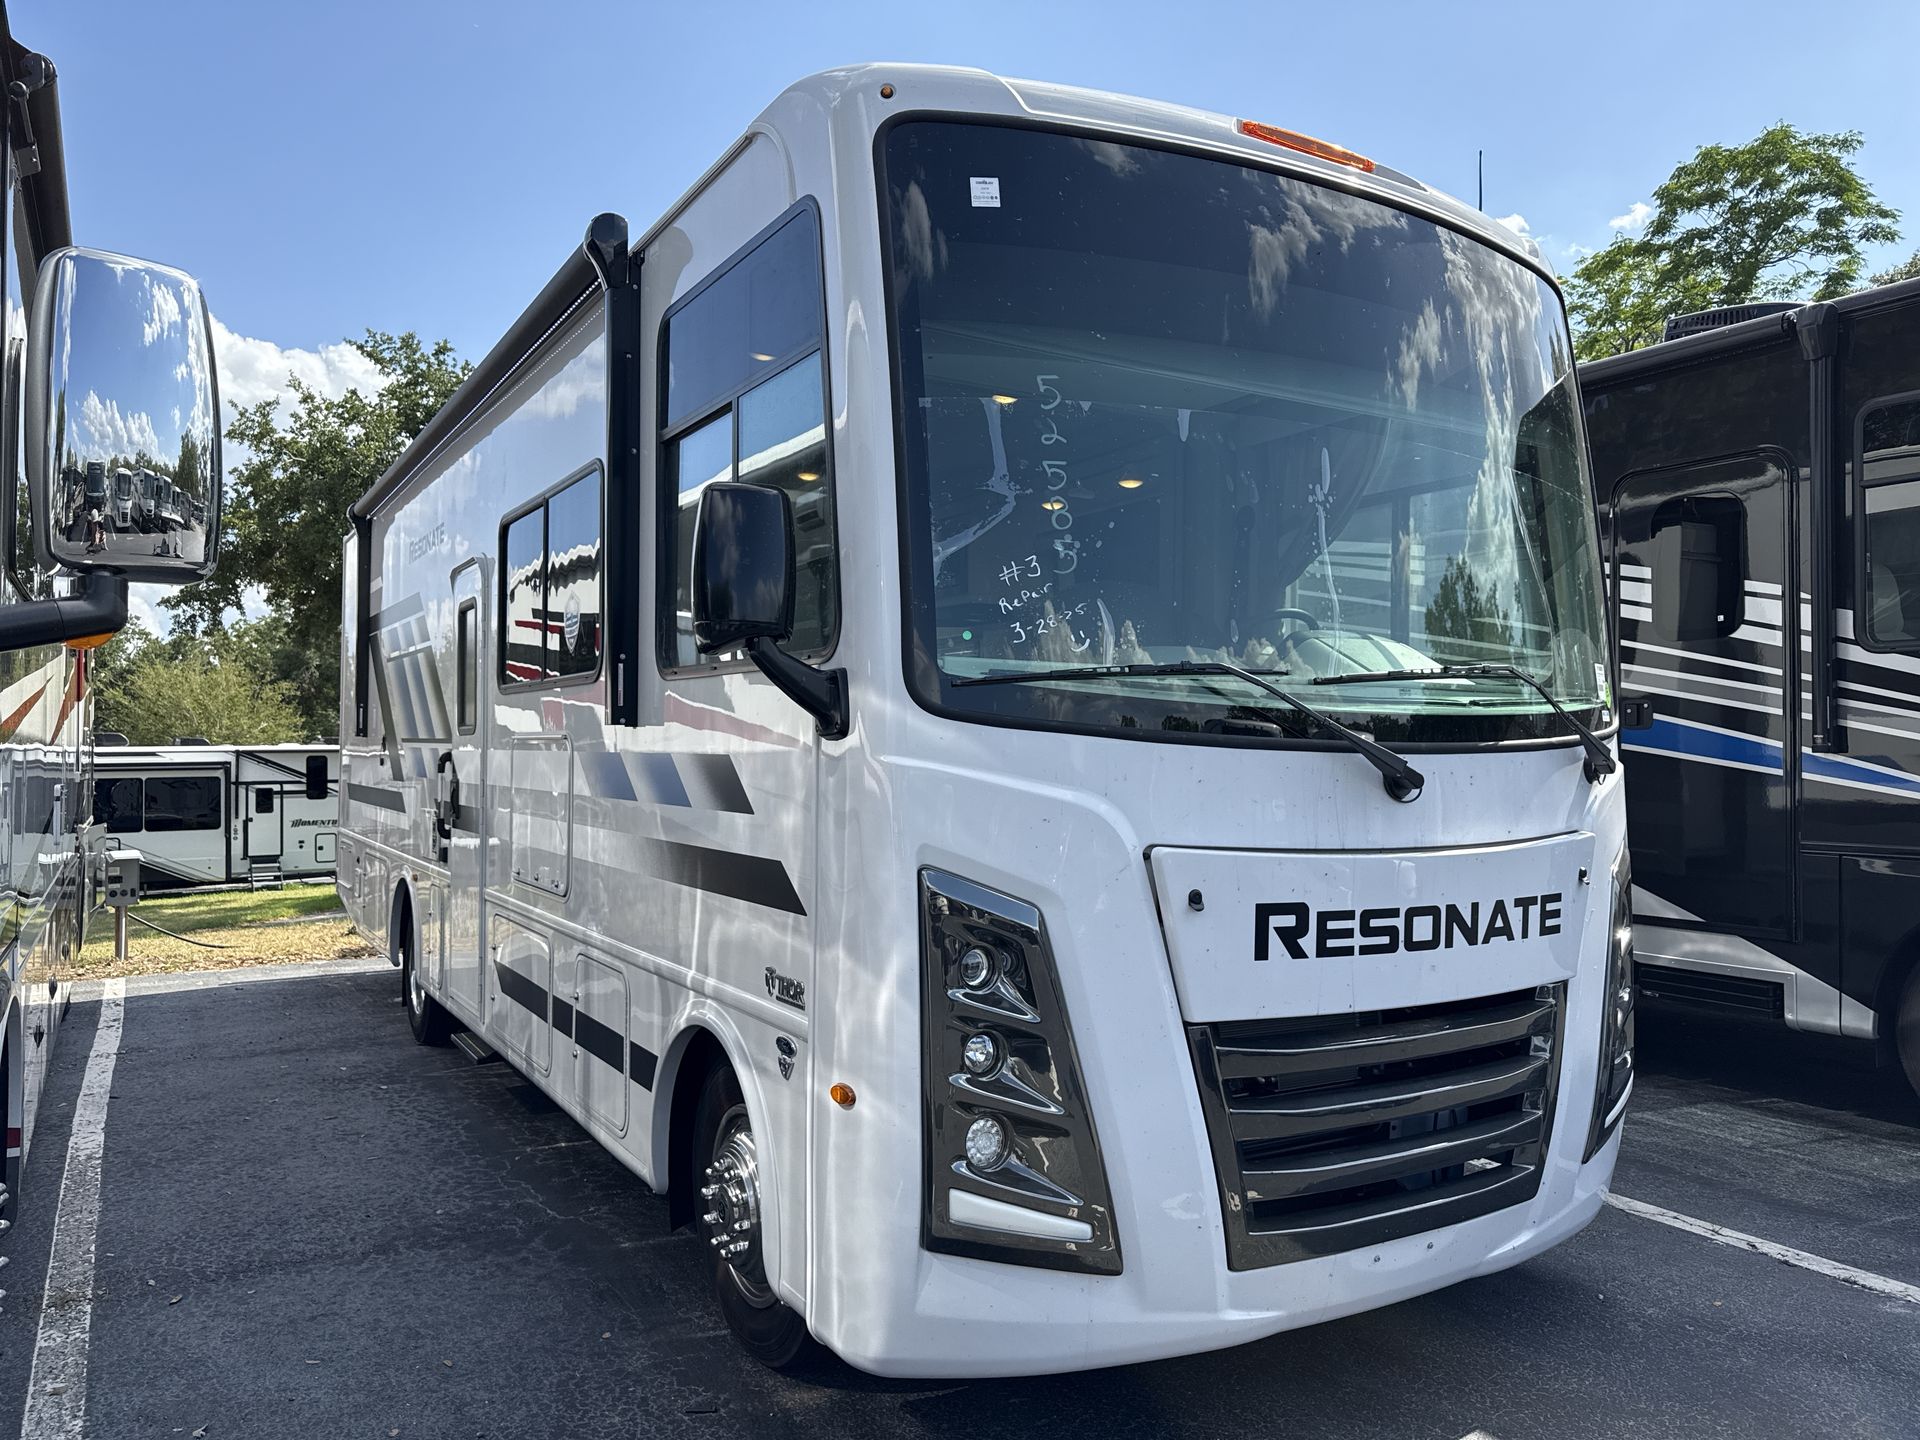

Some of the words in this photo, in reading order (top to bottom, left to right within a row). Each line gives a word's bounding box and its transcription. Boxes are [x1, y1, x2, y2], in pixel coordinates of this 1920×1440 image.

[408, 521, 445, 565] RESONATE
[999, 554, 1041, 587] #3
[1009, 603, 1088, 644] 3-28-25
[289, 818, 338, 828] MOMENTU
[1253, 892, 1563, 962] RESONATE
[774, 974, 806, 1004] THOR
